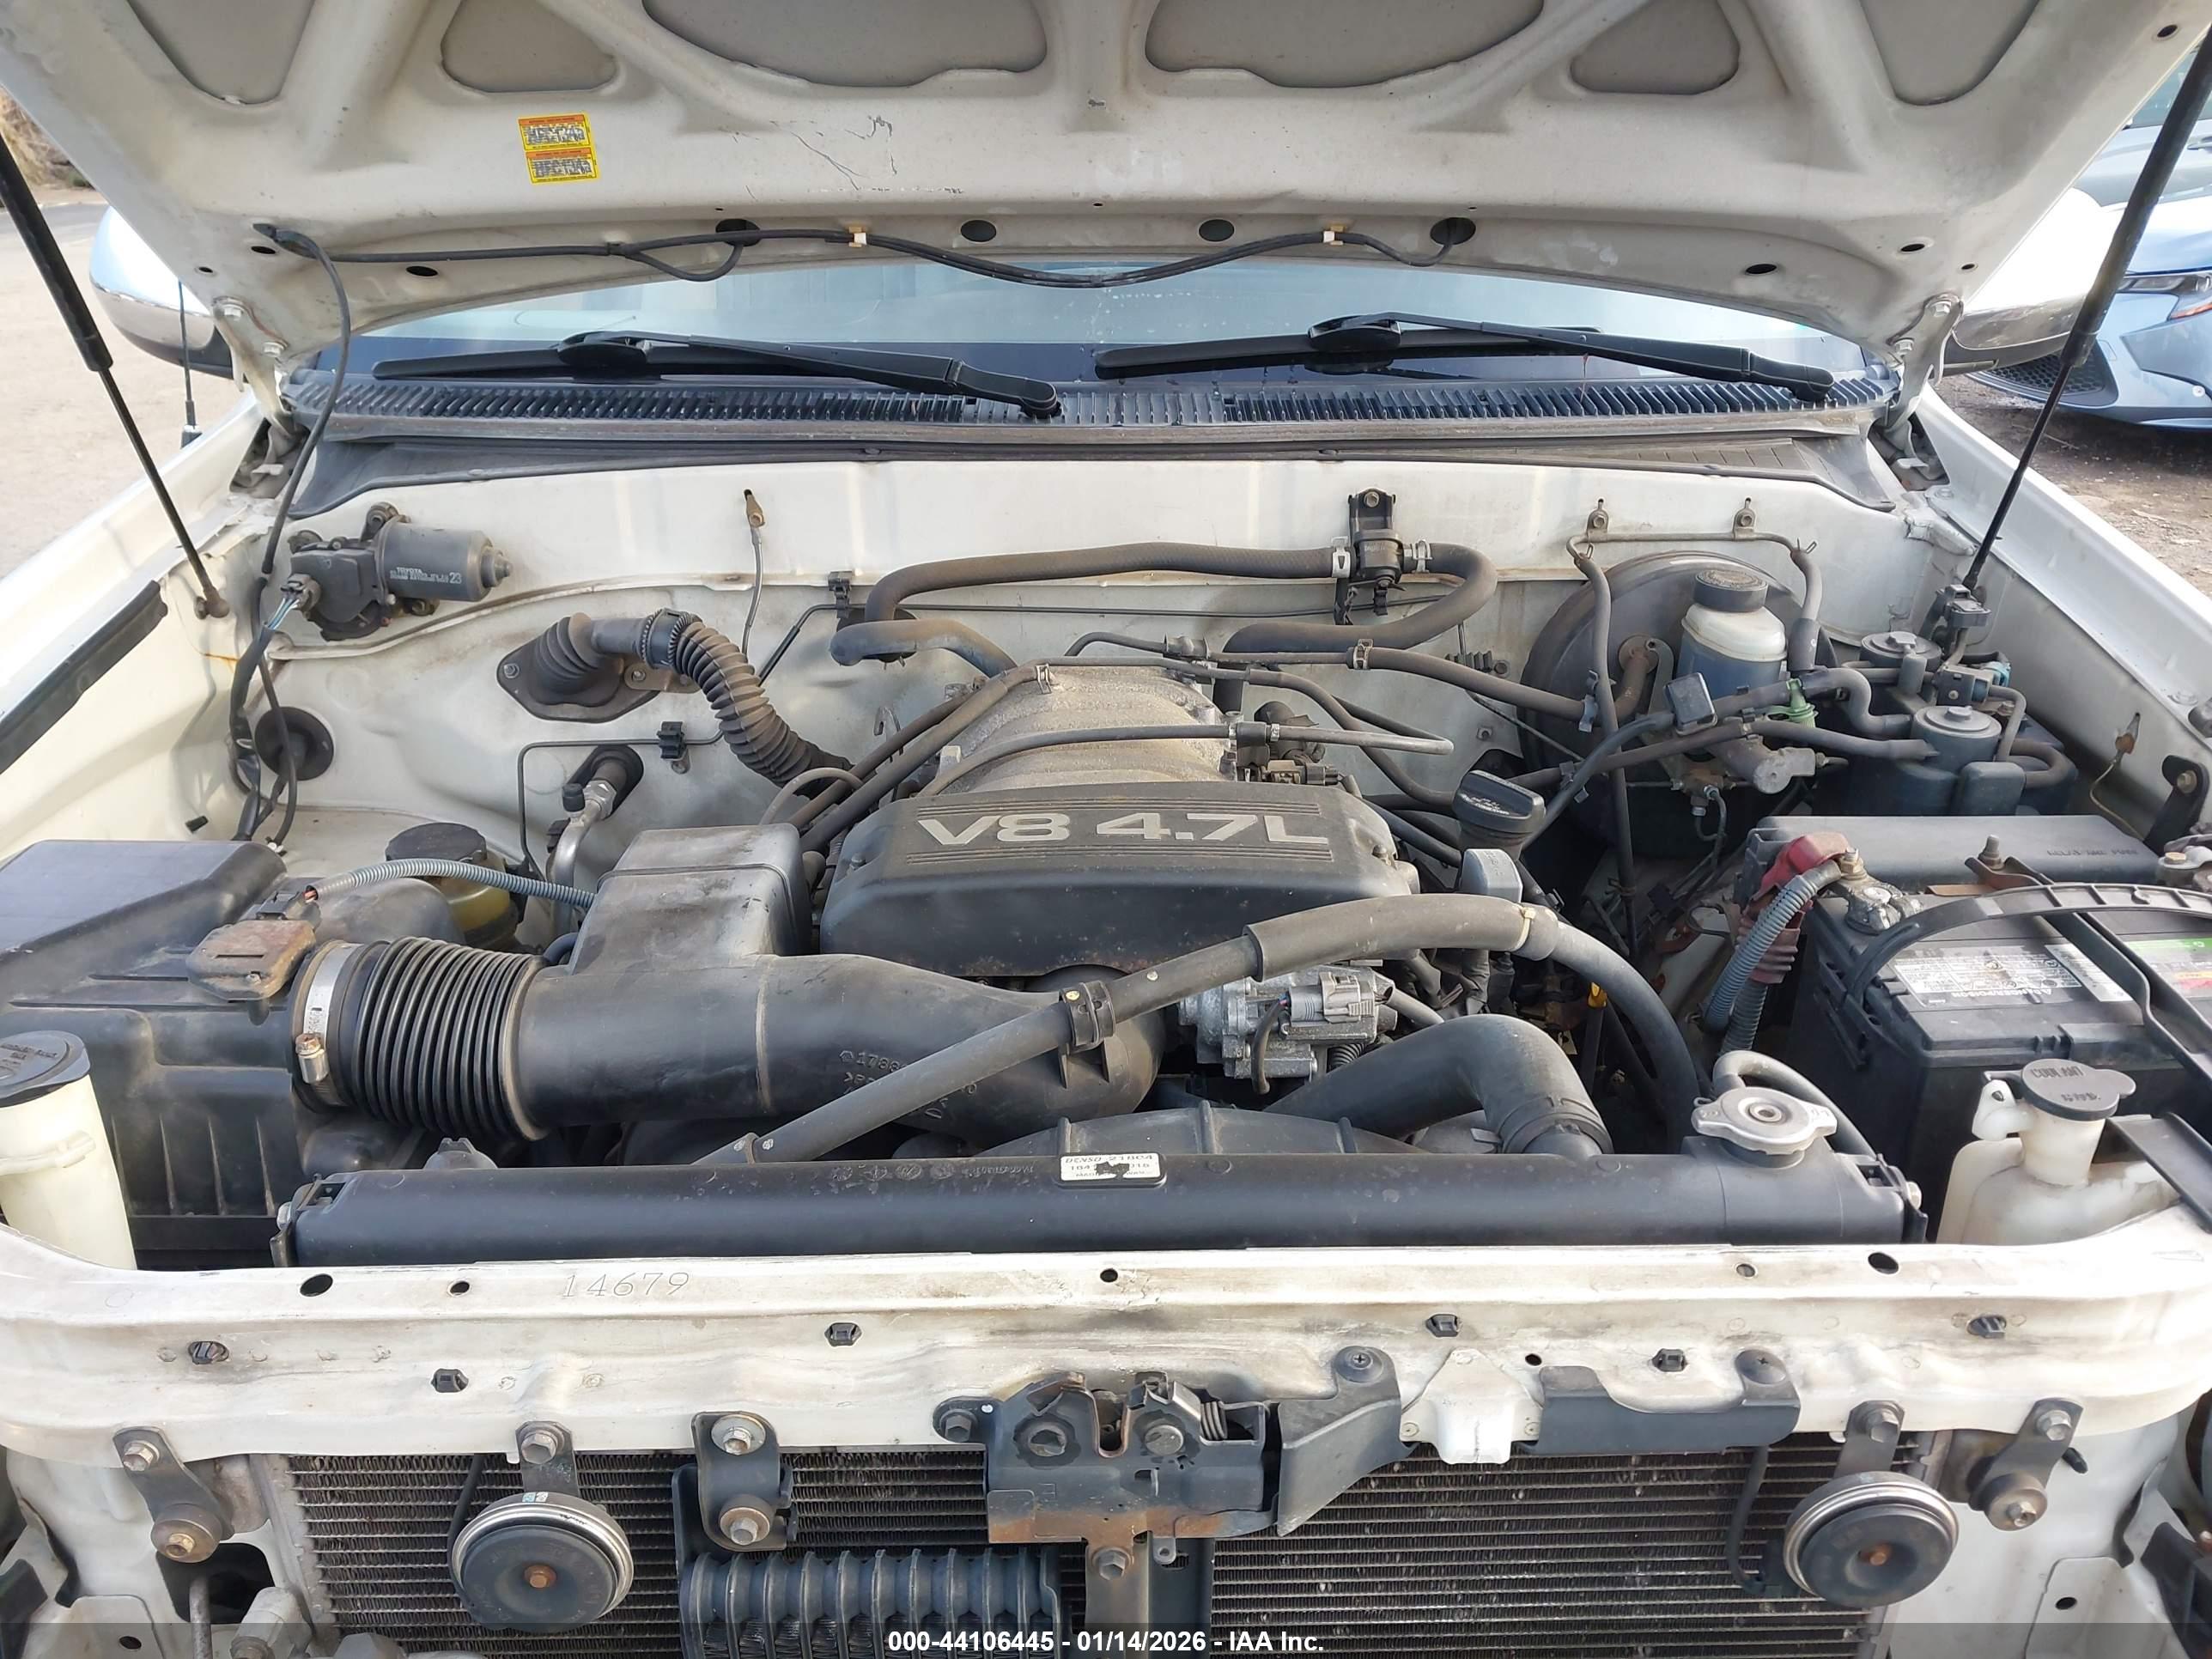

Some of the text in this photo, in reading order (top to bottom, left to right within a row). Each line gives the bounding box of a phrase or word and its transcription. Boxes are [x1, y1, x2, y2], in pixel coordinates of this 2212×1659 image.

[449, 572, 462, 584] 23
[917, 812, 1328, 846] V8 4.7L
[2029, 1066, 2084, 1079] COOLANT
[562, 1272, 690, 1297] 14679
